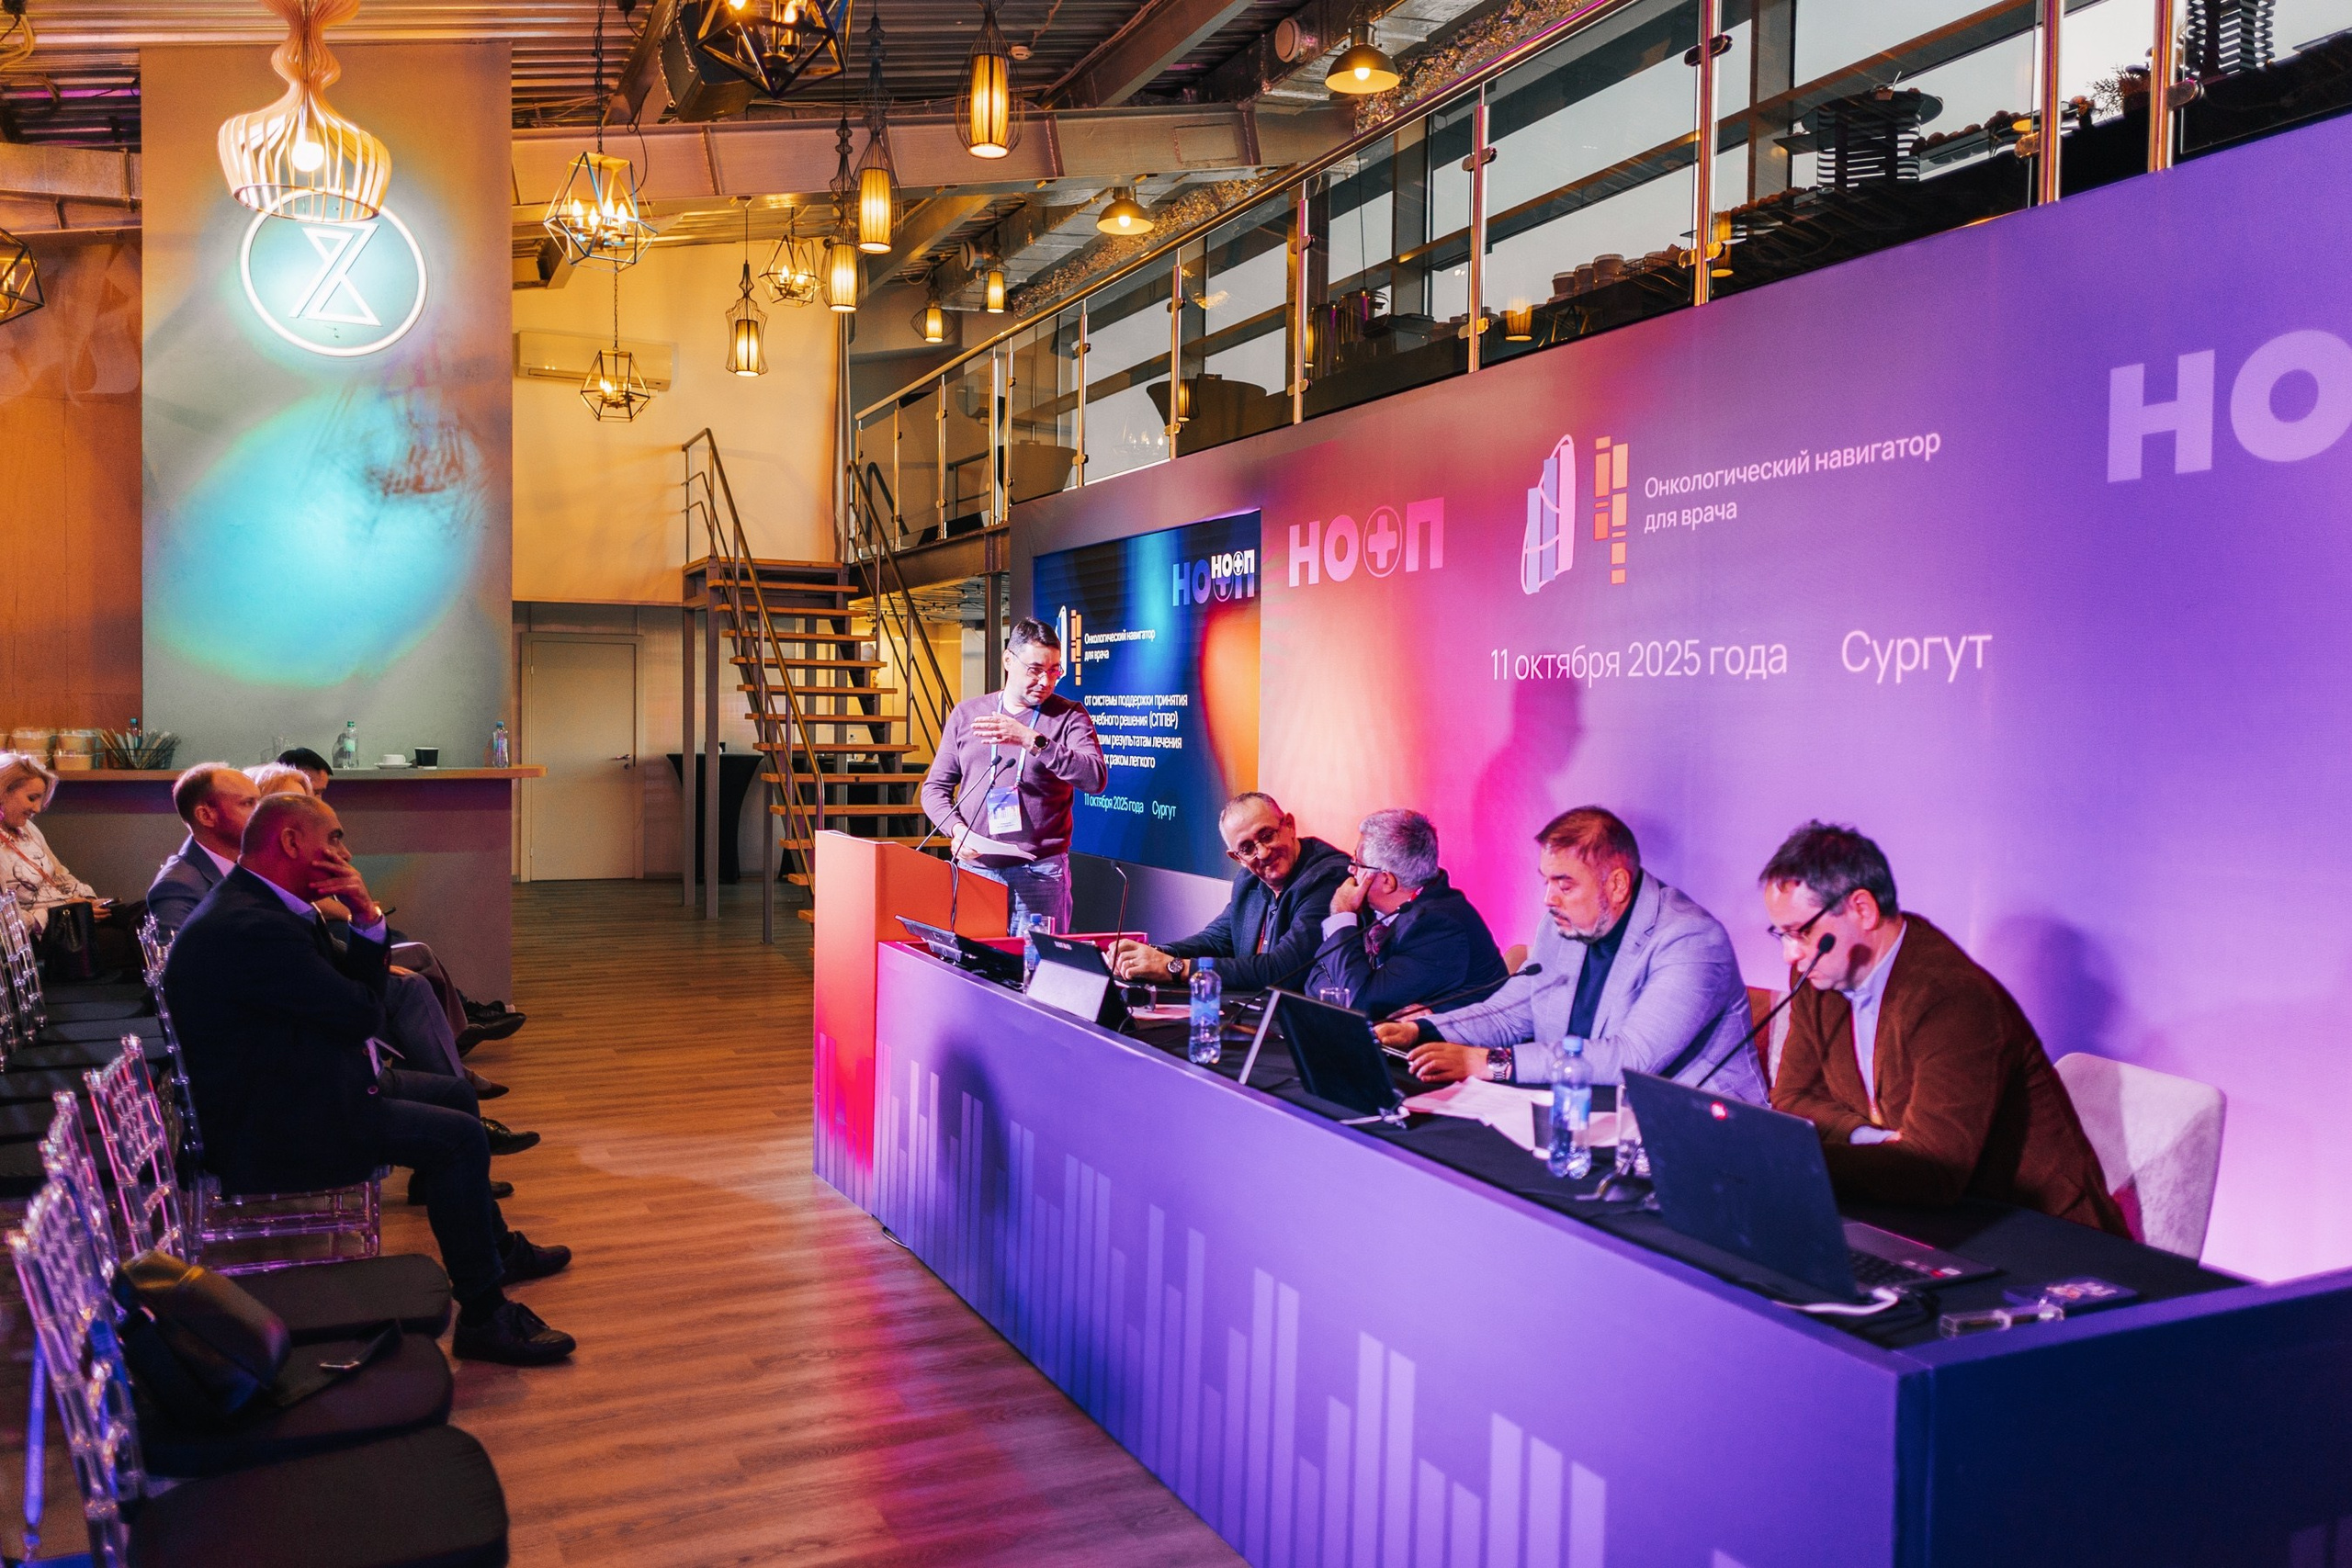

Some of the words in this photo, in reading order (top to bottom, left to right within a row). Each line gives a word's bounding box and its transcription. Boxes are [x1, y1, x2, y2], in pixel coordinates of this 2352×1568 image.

[1644, 449, 1810, 499] Онкологический
[1814, 432, 1941, 472] навигатор
[1644, 510, 1677, 534] для
[1680, 502, 1738, 531] врача
[1084, 629, 1126, 645] Онкологический
[1126, 629, 1156, 642] навигатор
[1490, 648, 1509, 681] 11
[1514, 644, 1621, 689] октября
[1627, 639, 1701, 678] 2025
[1709, 643, 1788, 681] года
[1841, 630, 1994, 684] Сургут
[1084, 694, 1091, 706] от
[1091, 694, 1118, 706] системы
[1118, 694, 1154, 710] поддержки
[1154, 694, 1188, 710] принятия
[1119, 716, 1148, 730] решения
[1148, 710, 1179, 730] (СППВР)
[1111, 734, 1152, 750] результатам
[1152, 736, 1182, 750] лечения
[1110, 754, 1129, 769] раком
[1090, 795, 1114, 812] октября
[1113, 795, 1128, 811] 2025
[1128, 801, 1144, 815] года
[1151, 800, 1177, 821] Сургут
